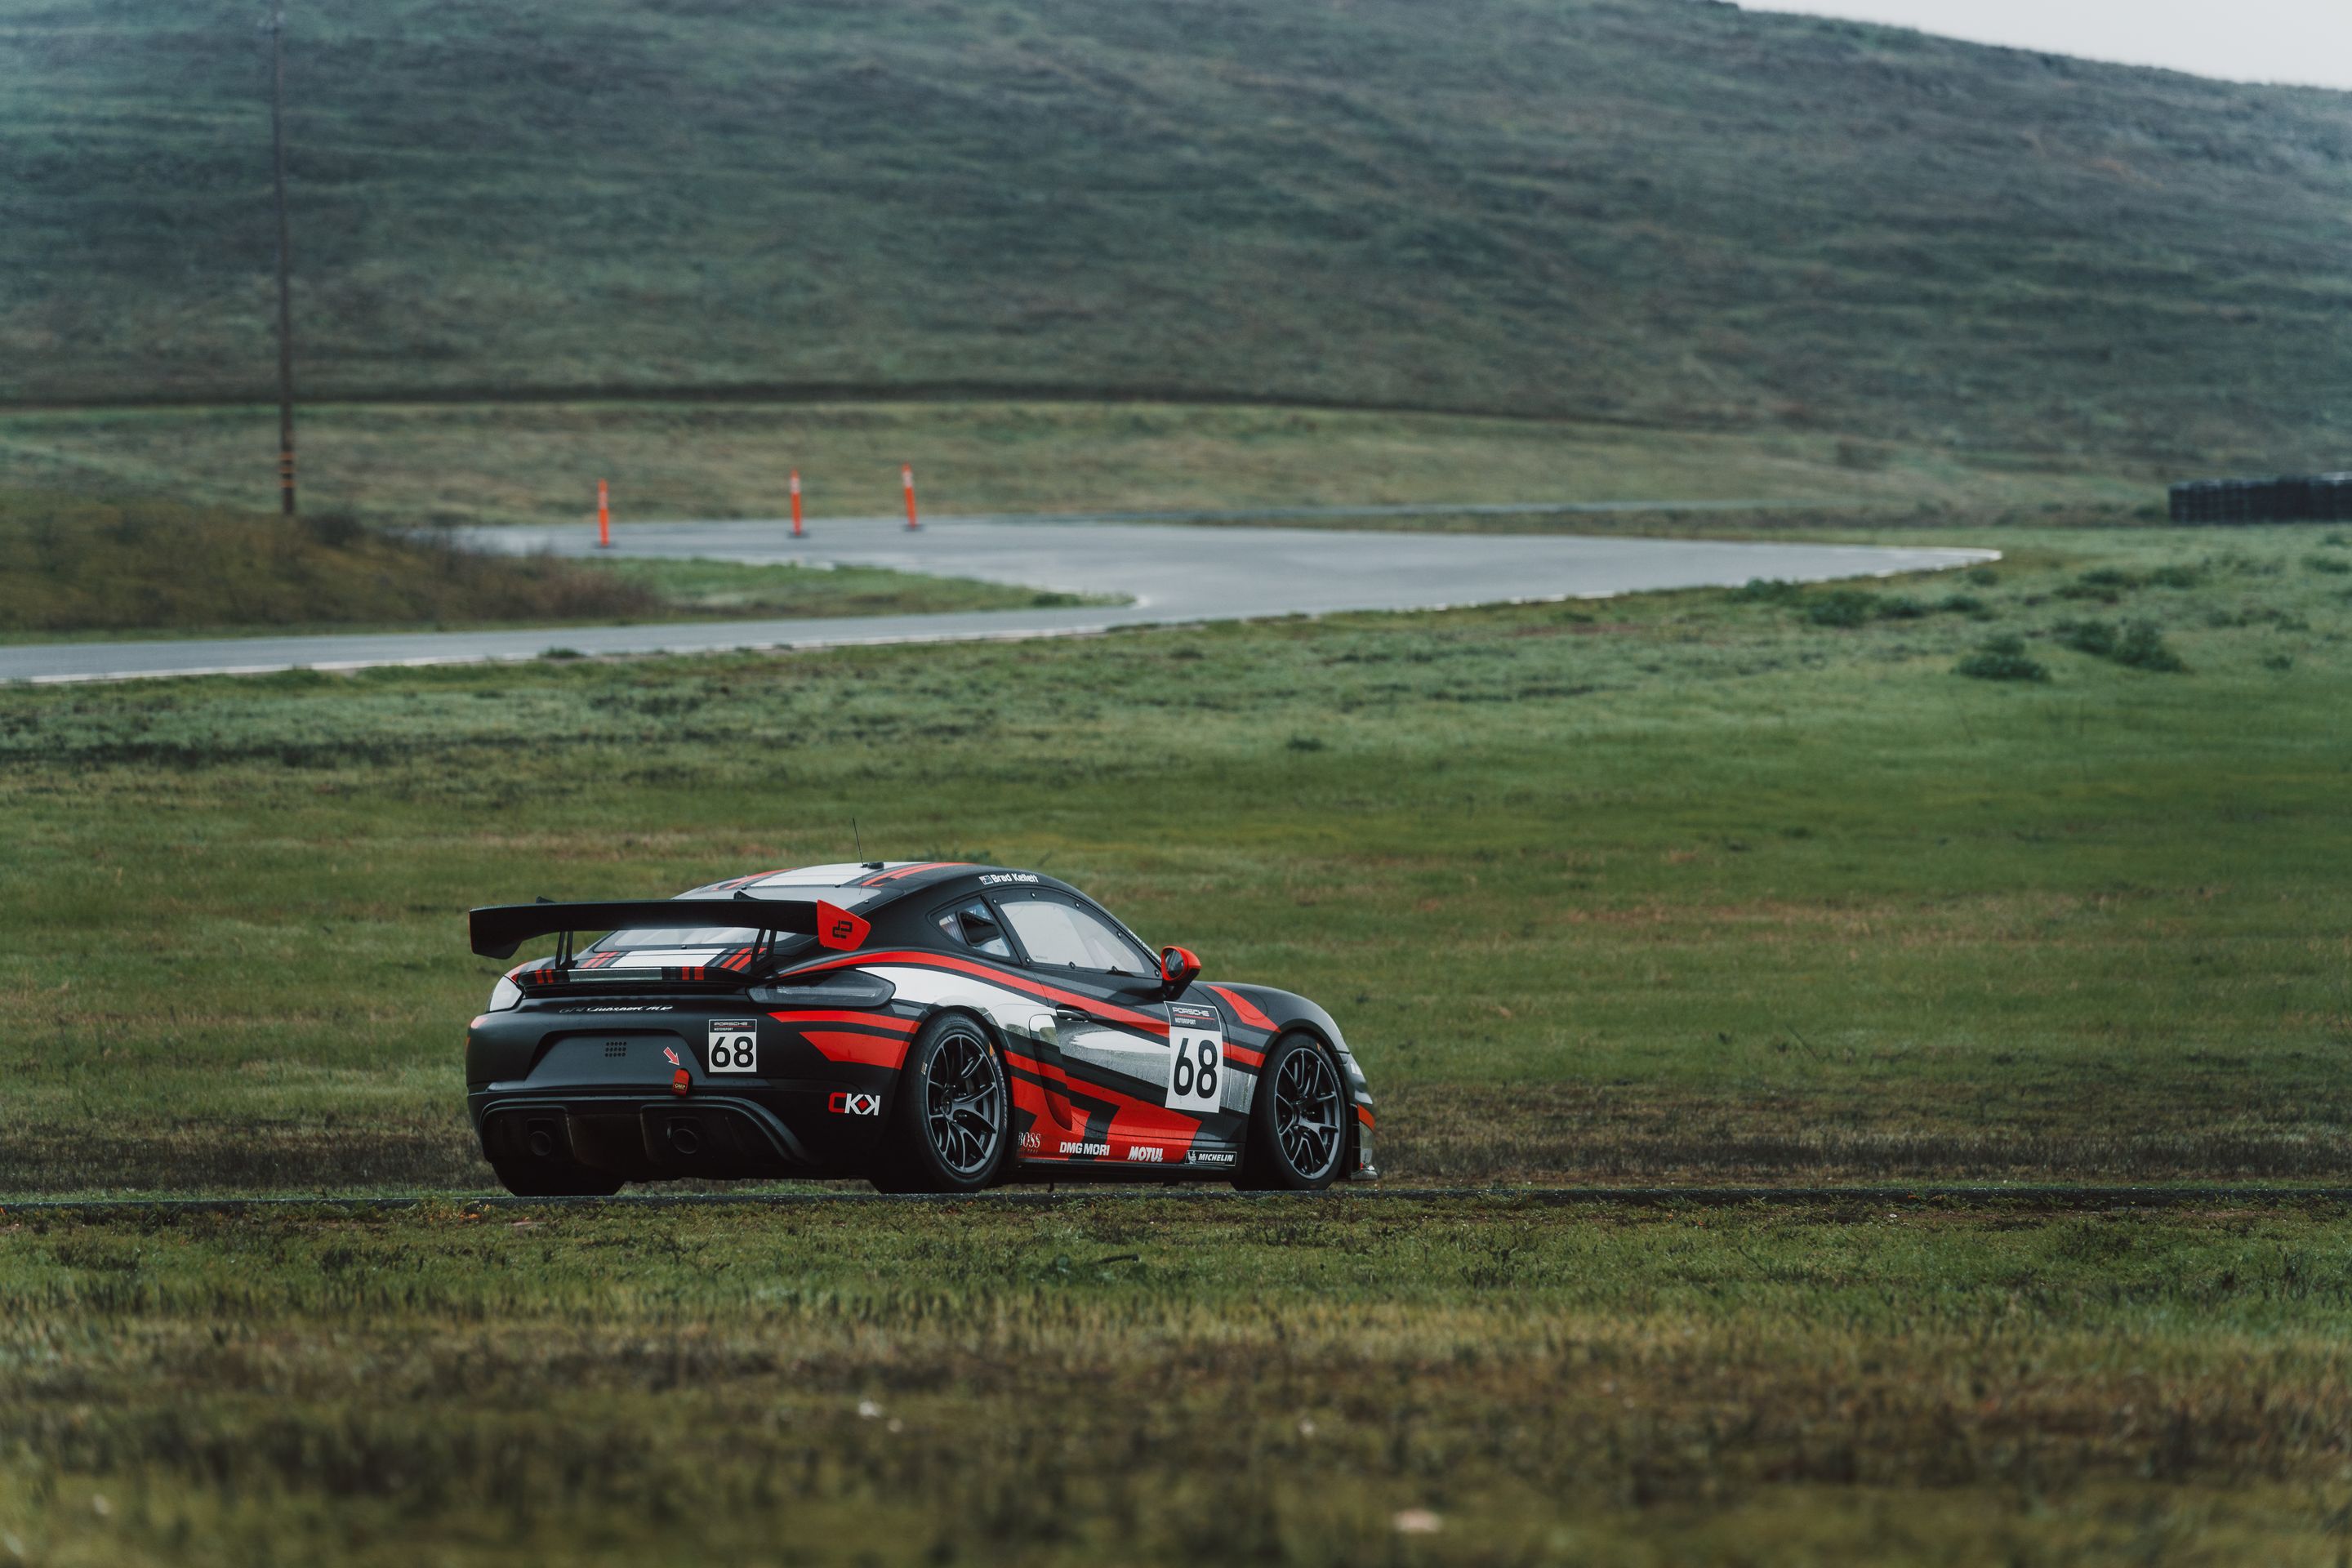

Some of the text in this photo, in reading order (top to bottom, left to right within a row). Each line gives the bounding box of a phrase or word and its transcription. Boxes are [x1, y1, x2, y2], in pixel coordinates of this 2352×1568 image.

[990, 873, 1039, 883] Brad Kellett
[1173, 1007, 1209, 1017] PORSCHE
[711, 1036, 754, 1068] 68
[1174, 1037, 1218, 1099] 68
[1059, 1142, 1110, 1156] DMG MORI
[1127, 1146, 1164, 1162] MOTUL
[1197, 1152, 1234, 1162] MICHELIN
